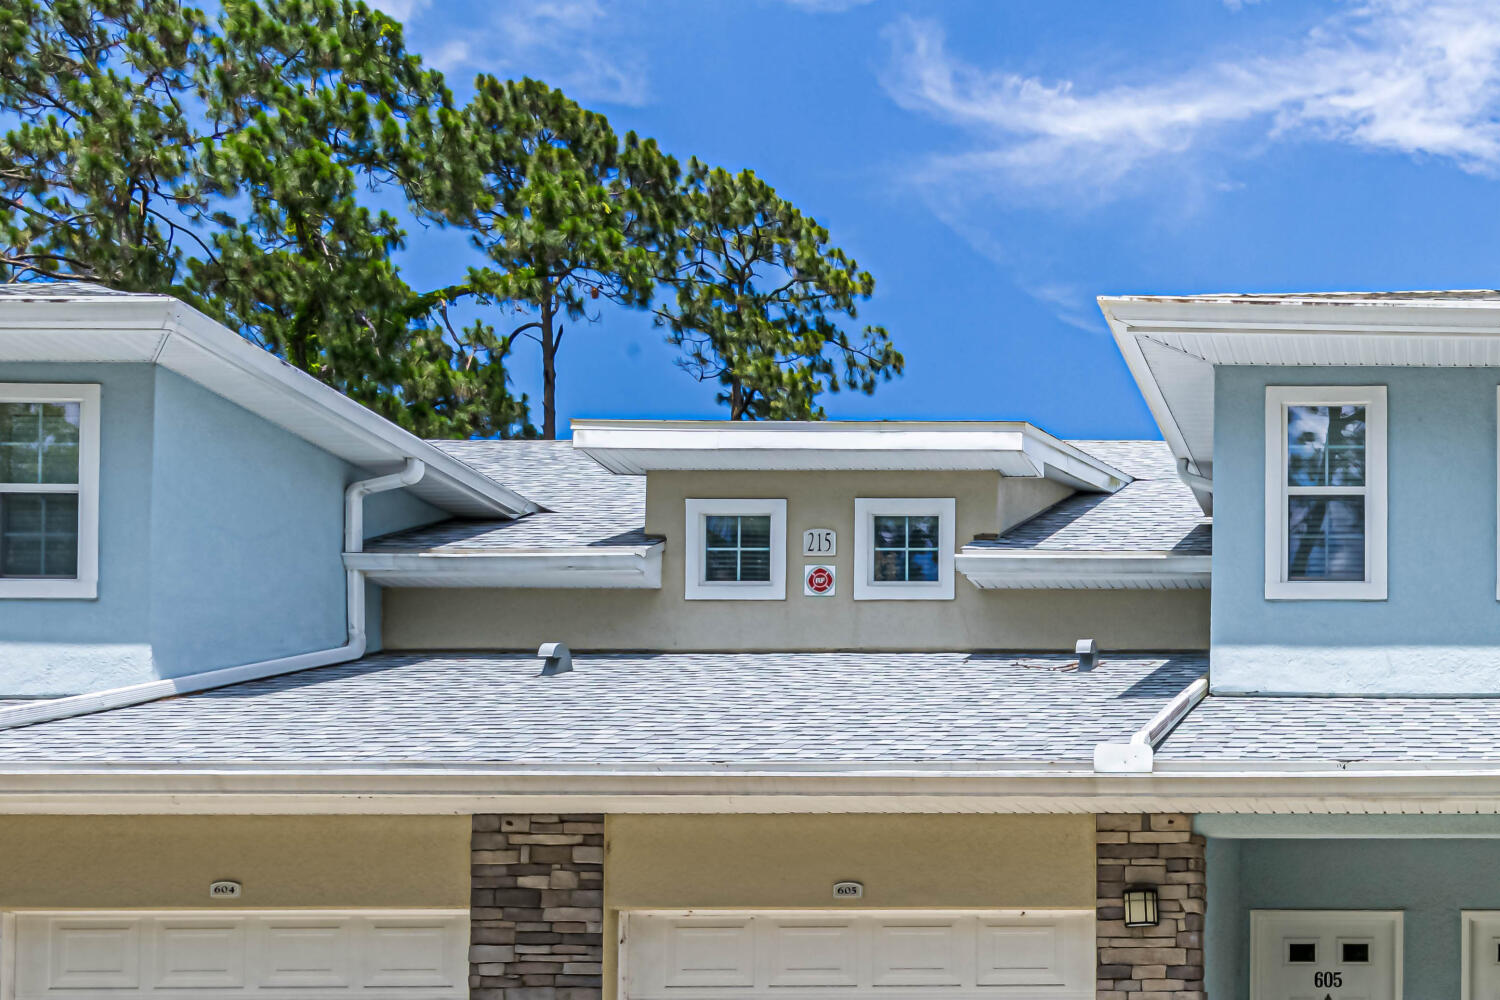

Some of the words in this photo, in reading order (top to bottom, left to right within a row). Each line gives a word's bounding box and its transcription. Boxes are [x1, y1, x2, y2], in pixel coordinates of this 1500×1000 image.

[808, 532, 832, 552] 215
[214, 885, 235, 894] 604
[837, 886, 857, 895] 605
[1314, 971, 1343, 989] 605
